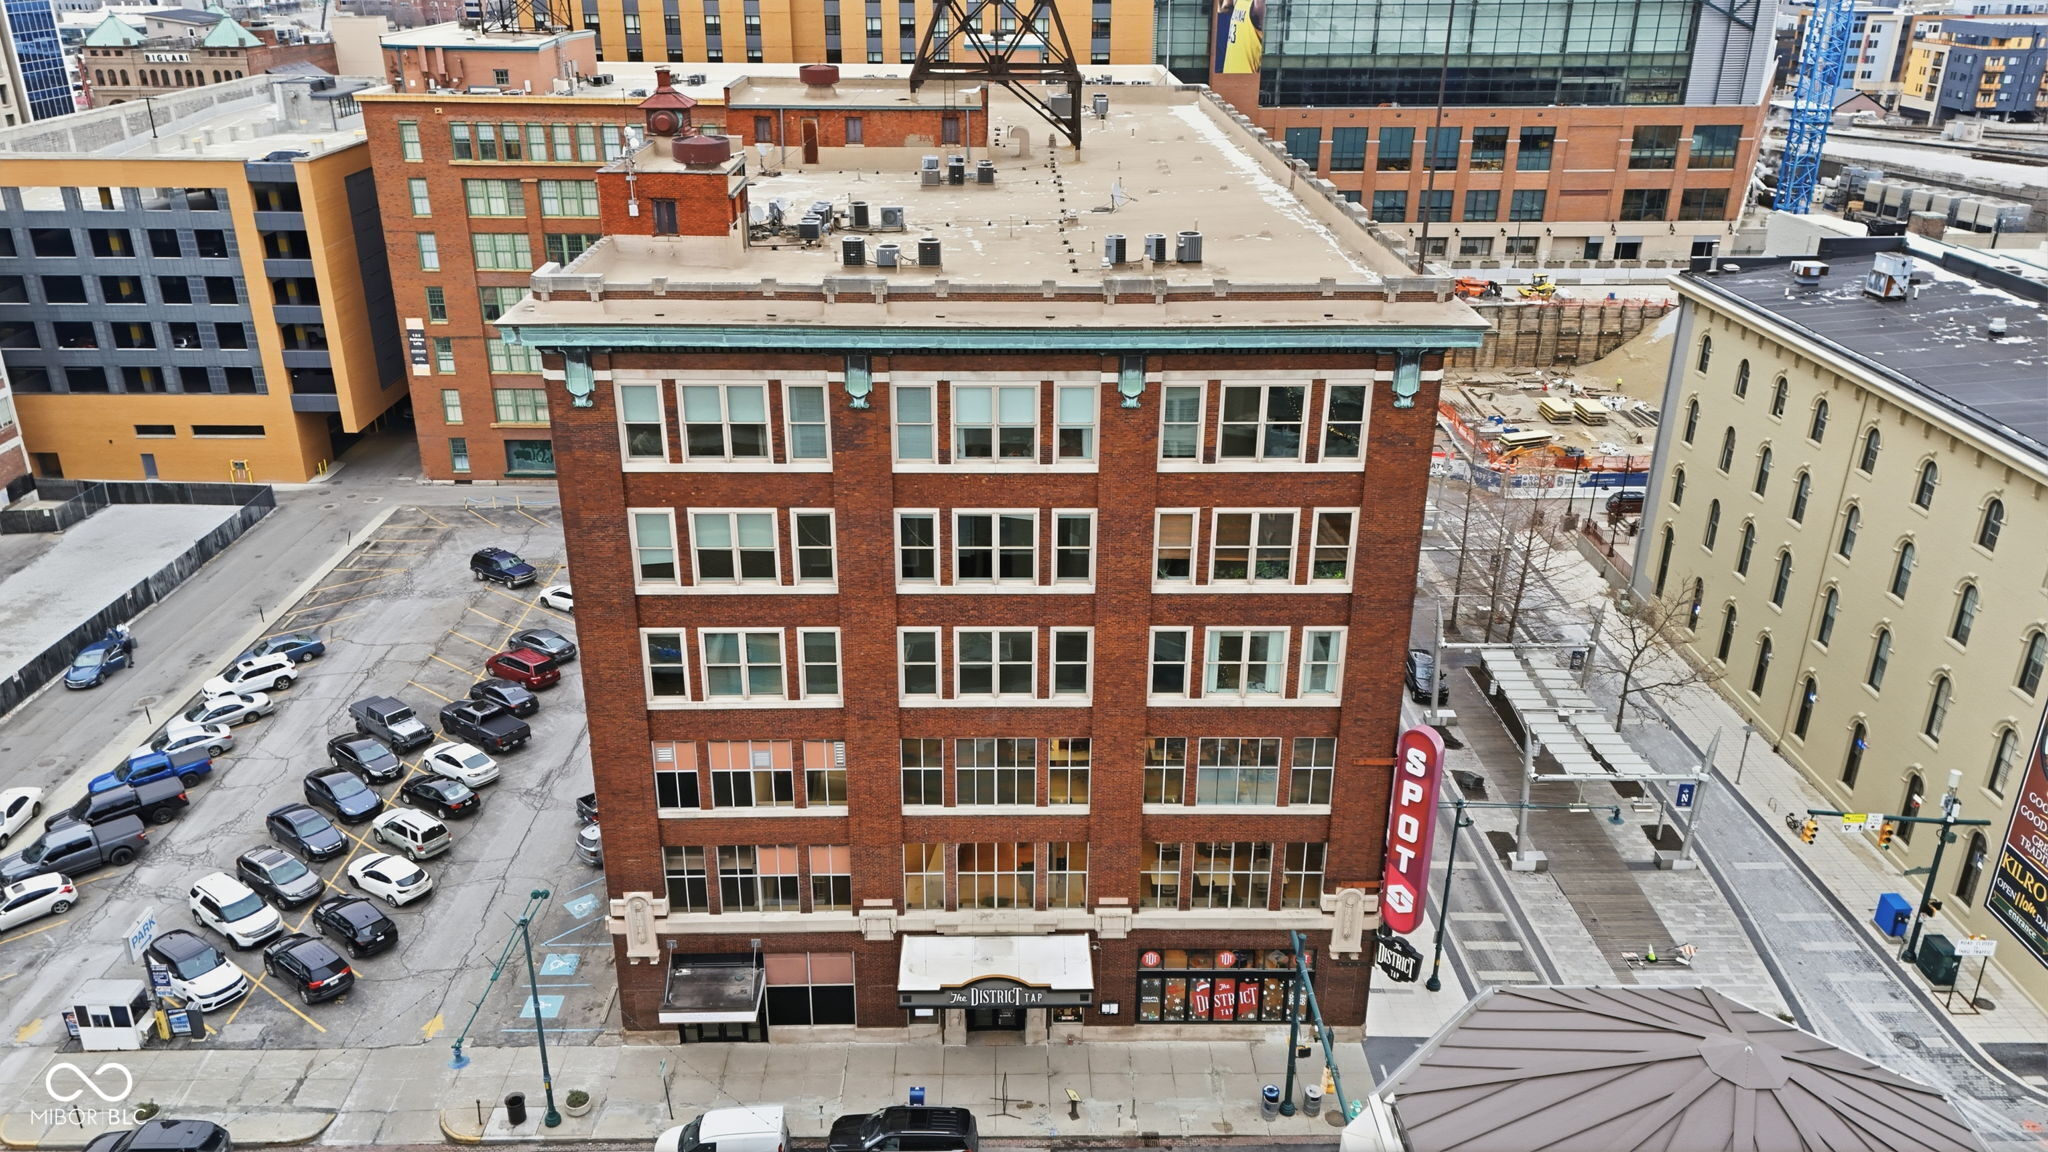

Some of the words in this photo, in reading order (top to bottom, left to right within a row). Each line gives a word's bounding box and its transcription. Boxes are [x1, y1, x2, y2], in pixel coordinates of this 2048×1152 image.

[1395, 747, 1427, 874] SPOT
[2020, 805, 2047, 832] GOOD
[1997, 877, 2017, 900] OPEN
[131, 914, 156, 949] PARK
[2008, 908, 2037, 940] entrance
[1378, 942, 1415, 979] DISTRICT
[1390, 969, 1400, 980] TAP
[950, 992, 968, 1004] The
[970, 987, 1023, 1006] DISTRICT
[1024, 993, 1043, 1003] TAP
